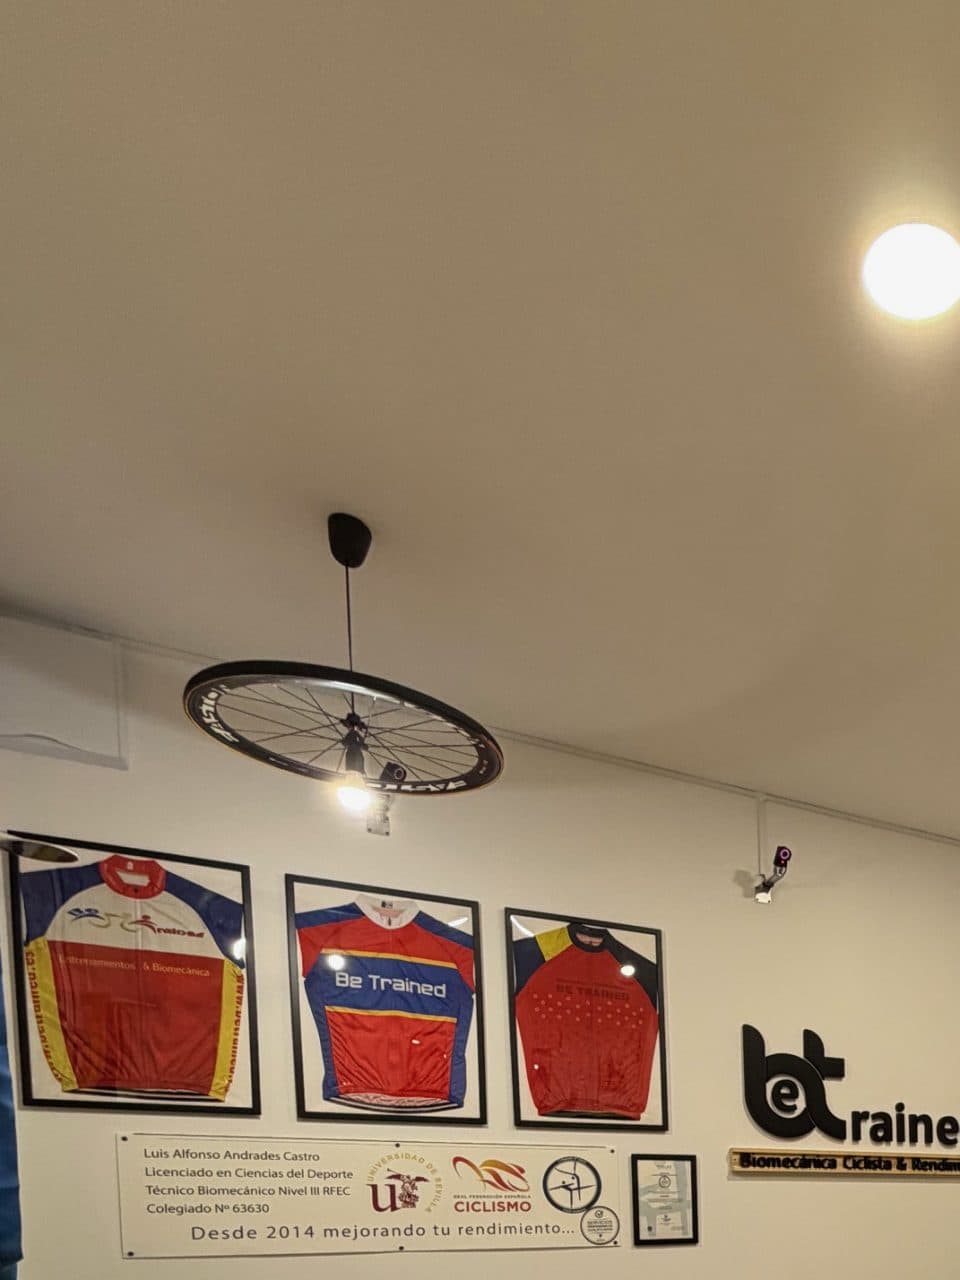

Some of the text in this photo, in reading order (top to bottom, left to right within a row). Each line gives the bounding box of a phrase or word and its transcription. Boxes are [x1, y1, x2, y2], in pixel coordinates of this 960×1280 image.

[336, 972, 447, 998] Be Trained
[143, 1148, 320, 1163] Luis Alfonso Andrades Castro
[739, 1152, 838, 1170] Biomecánica
[842, 1156, 893, 1172] Ciclista
[896, 1157, 907, 1171] &
[145, 1167, 354, 1181] Licenciado en Ciencias del Deporte
[366, 1151, 425, 1183] UNIVERSIDAD
[145, 1185, 351, 1196] Técnico Biomecánico Nivel III RFEC
[146, 1203, 212, 1216] Colegiado
[232, 1203, 270, 1214] 63630
[454, 1200, 532, 1213] CICLISMO
[191, 1222, 575, 1241] Desde 2014 mejorando tu rendimiento...
